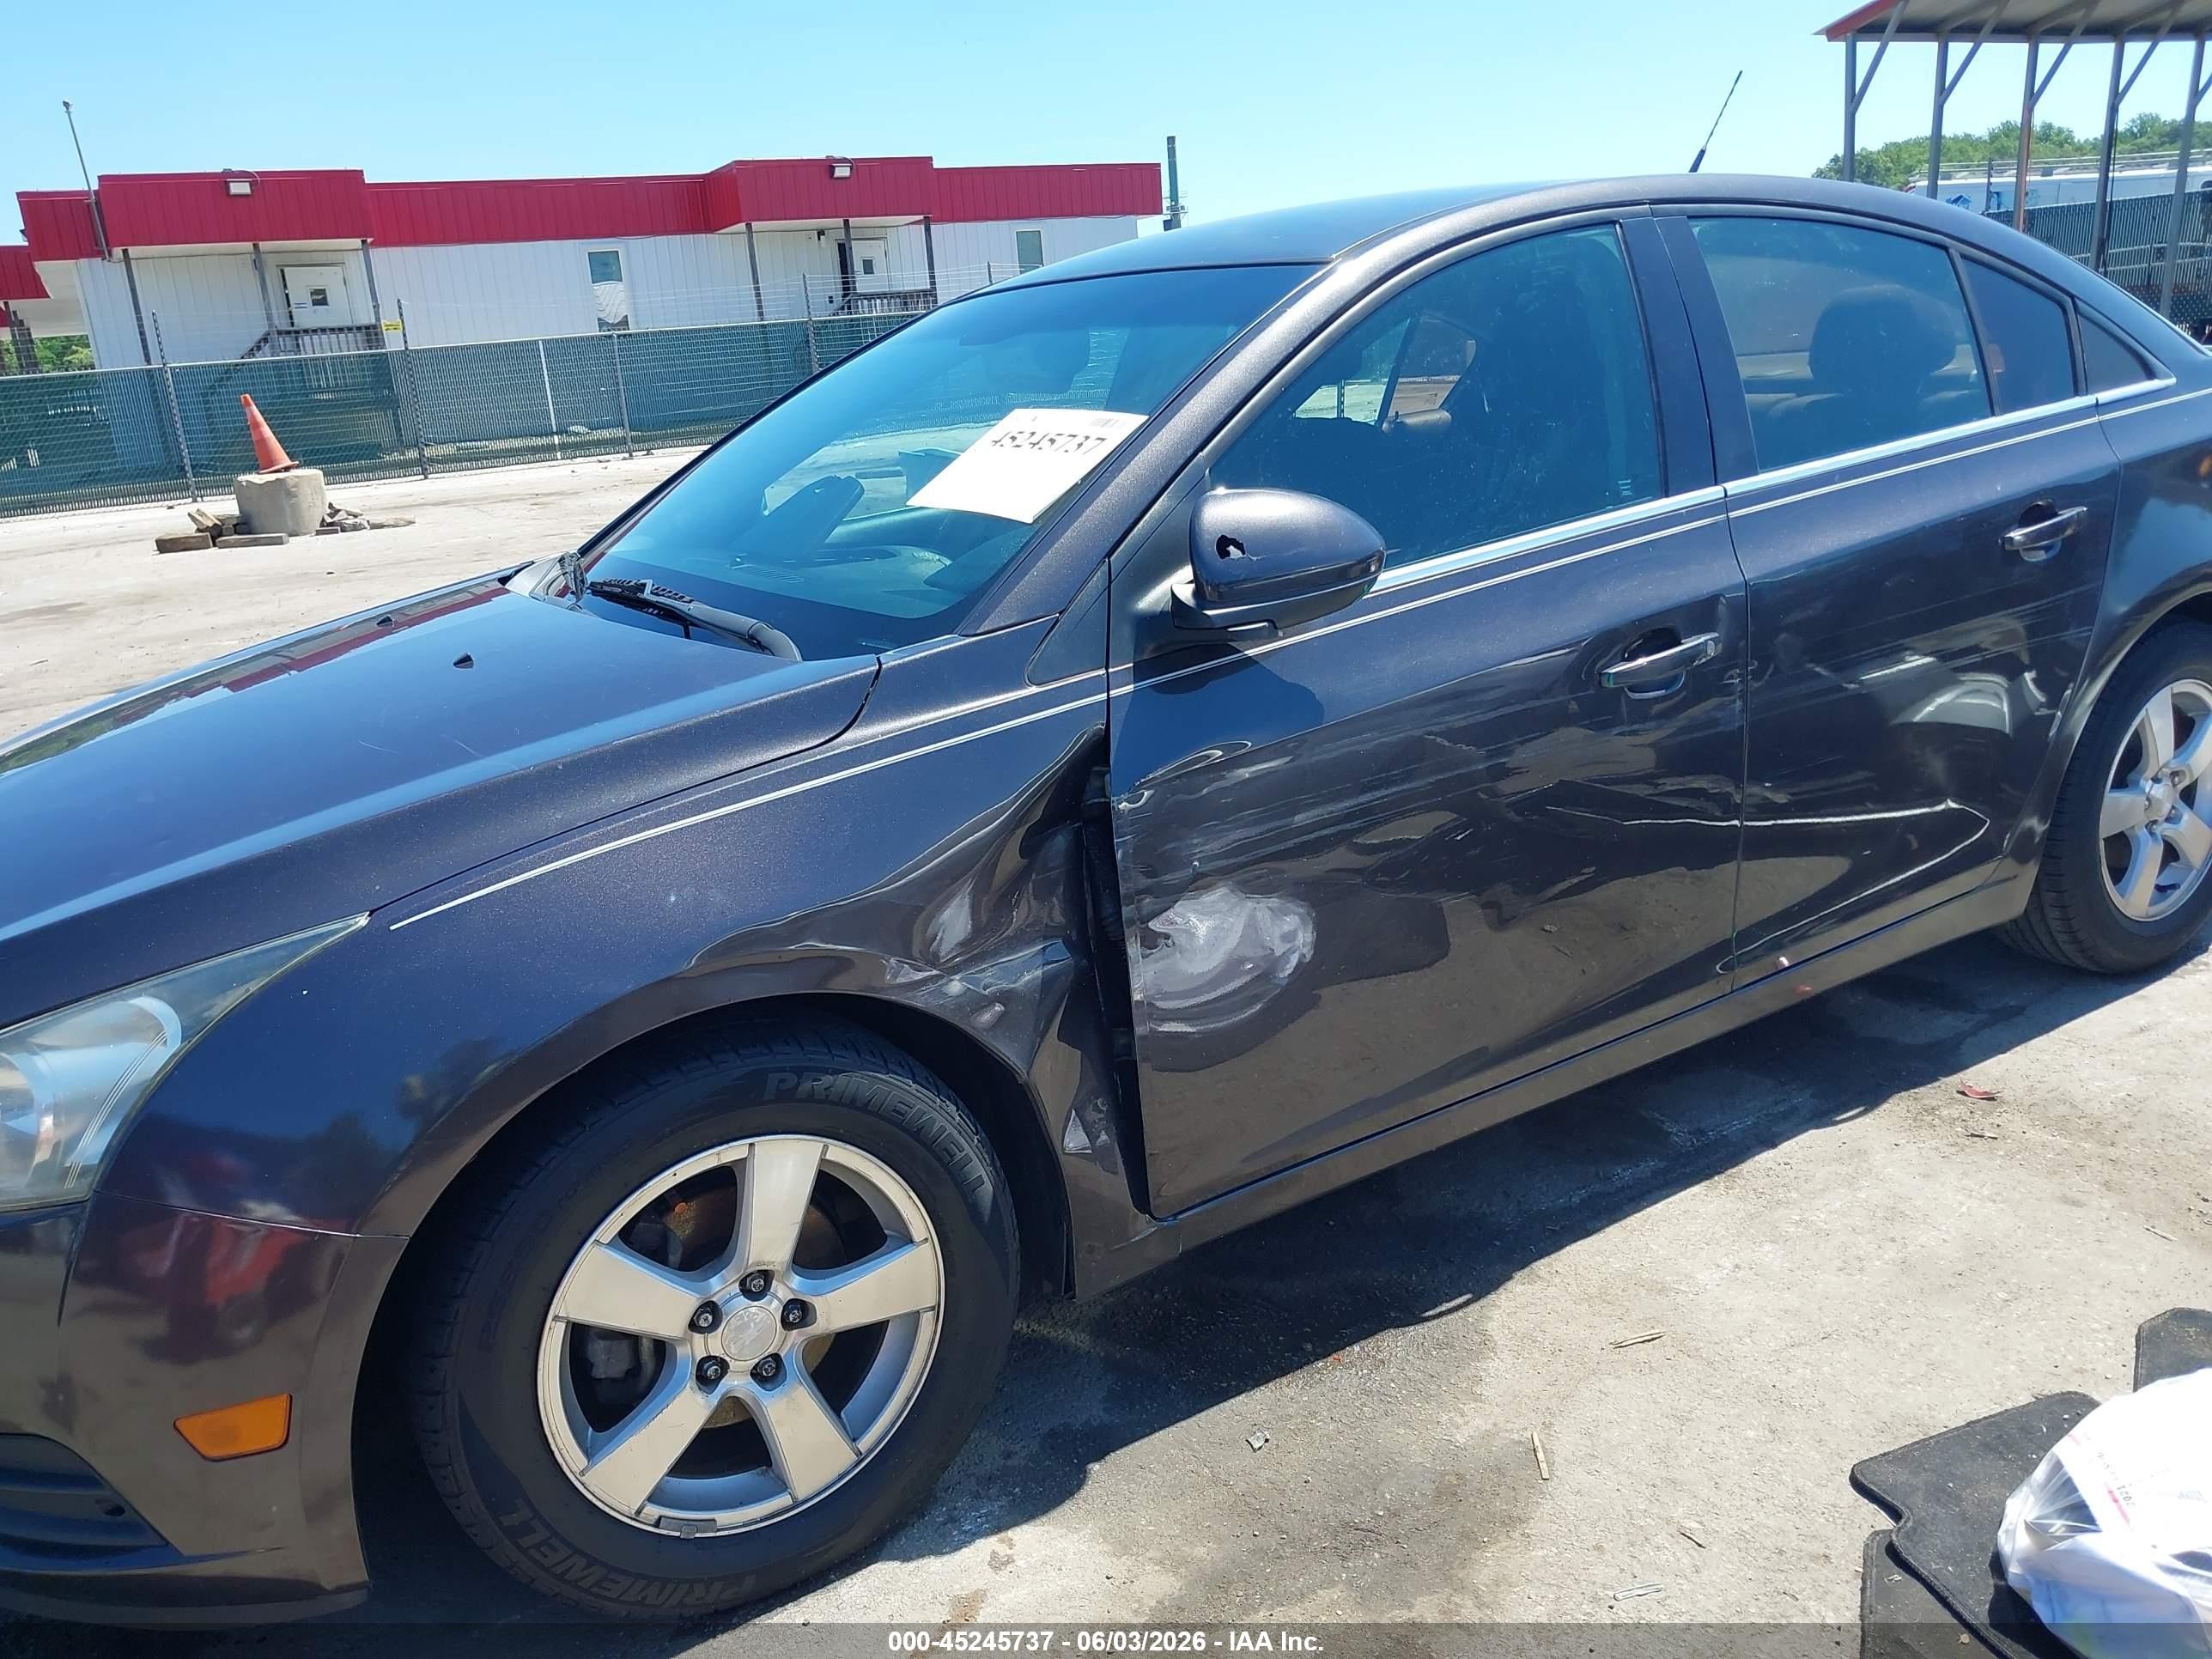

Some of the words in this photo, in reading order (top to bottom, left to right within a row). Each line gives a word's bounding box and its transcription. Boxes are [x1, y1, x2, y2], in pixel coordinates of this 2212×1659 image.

[991, 430, 1108, 454] 45245737
[763, 1073, 987, 1191] PRIMEWELL
[499, 1497, 757, 1607] PRIMEWELL
